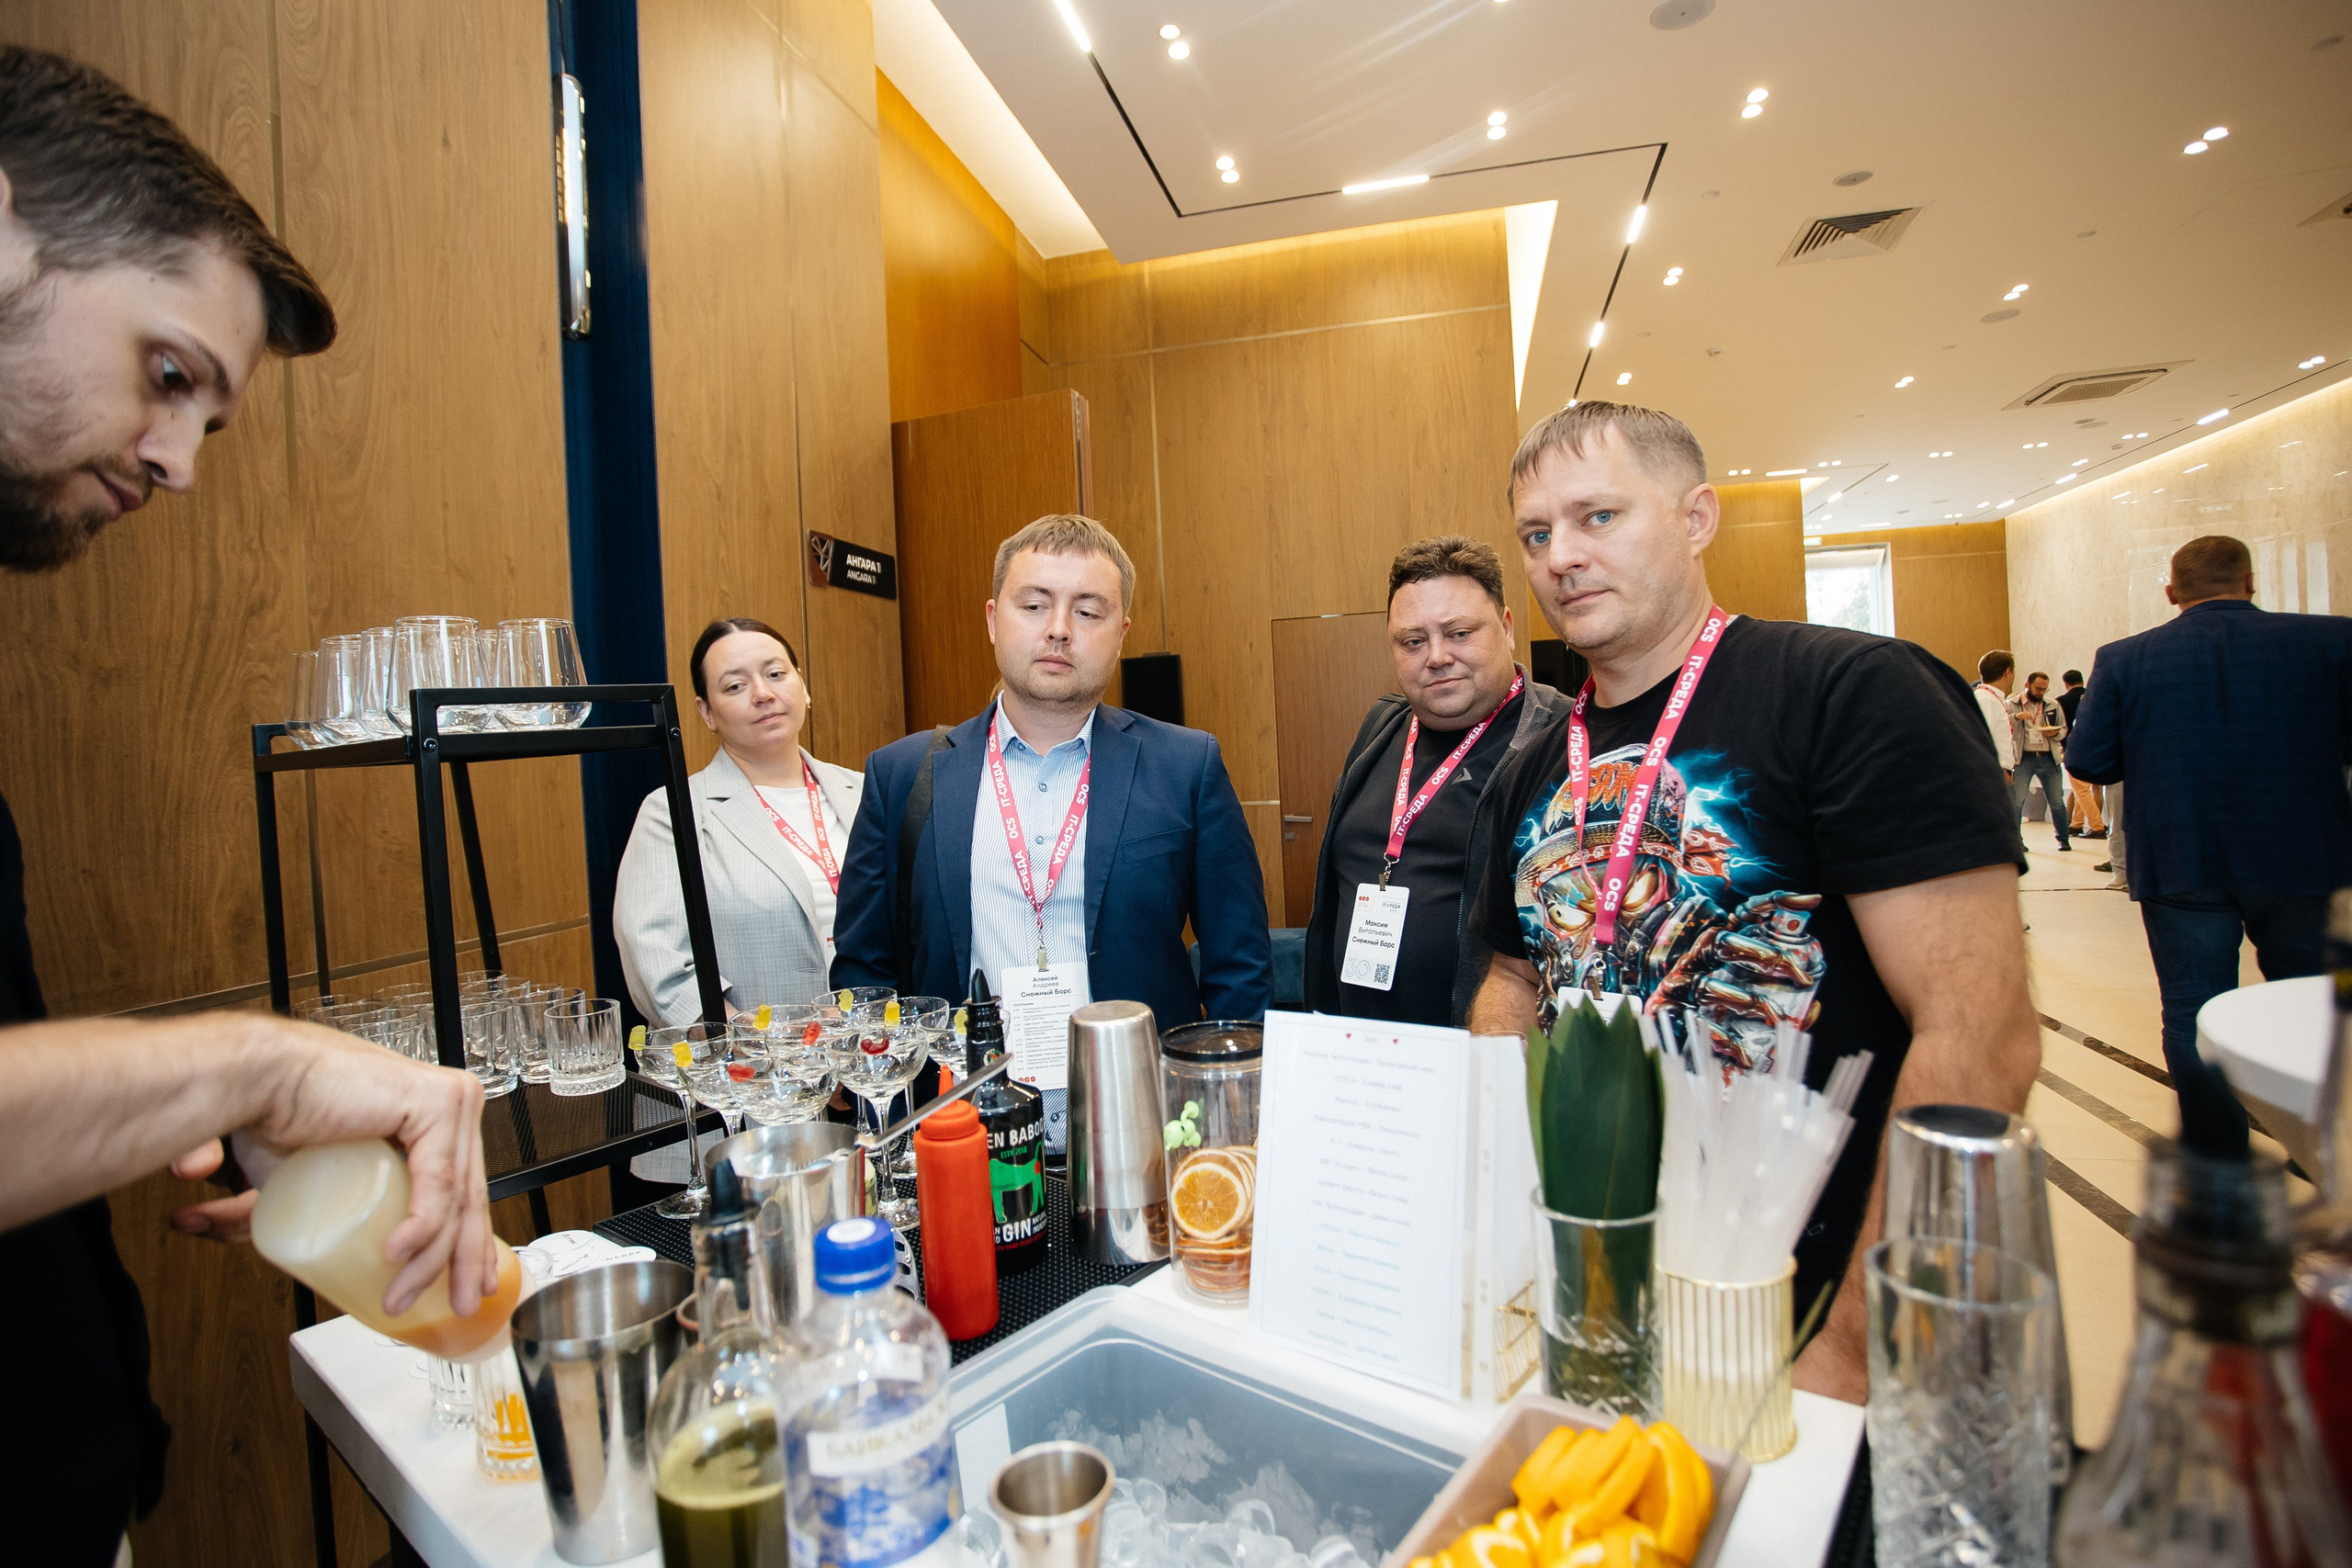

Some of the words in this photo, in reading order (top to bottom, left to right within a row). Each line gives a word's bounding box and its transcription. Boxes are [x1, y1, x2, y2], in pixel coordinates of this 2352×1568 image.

[846, 554, 876, 572] АНГАРА
[876, 562, 882, 574] 1
[1701, 617, 1722, 643] OCS
[1665, 655, 1704, 719] IT-СРЕДА
[1575, 690, 1588, 716] OCS
[1406, 742, 1414, 761] OCS
[1452, 721, 1487, 761] IT-СРЕДА
[1645, 736, 1668, 767] OCS
[1570, 726, 1585, 783] IT-СРЕДА
[992, 761, 1012, 807] IT-СРЕДА
[1396, 767, 1410, 807] IT-СРЕДА
[1430, 766, 1449, 785] OCS
[1077, 784, 1090, 806] OCS
[1396, 794, 1429, 836] IT-СРЕДА
[1574, 796, 1584, 826] OCS
[1615, 784, 1649, 858] IT-СРЕДА
[782, 827, 813, 855] IT-СРЕДА
[817, 827, 826, 841] OCS
[1006, 818, 1019, 840] OCS
[1053, 814, 1080, 865] IT-СРЕДА
[1603, 877, 1623, 912] OCS
[1358, 927, 1393, 937] Витальевич
[1365, 919, 1389, 929] Максим
[1351, 936, 1379, 946] Снежный
[1379, 942, 1396, 950] Барс
[1021, 989, 1054, 998] Снежный
[1002, 1218, 1032, 1243] GIN
